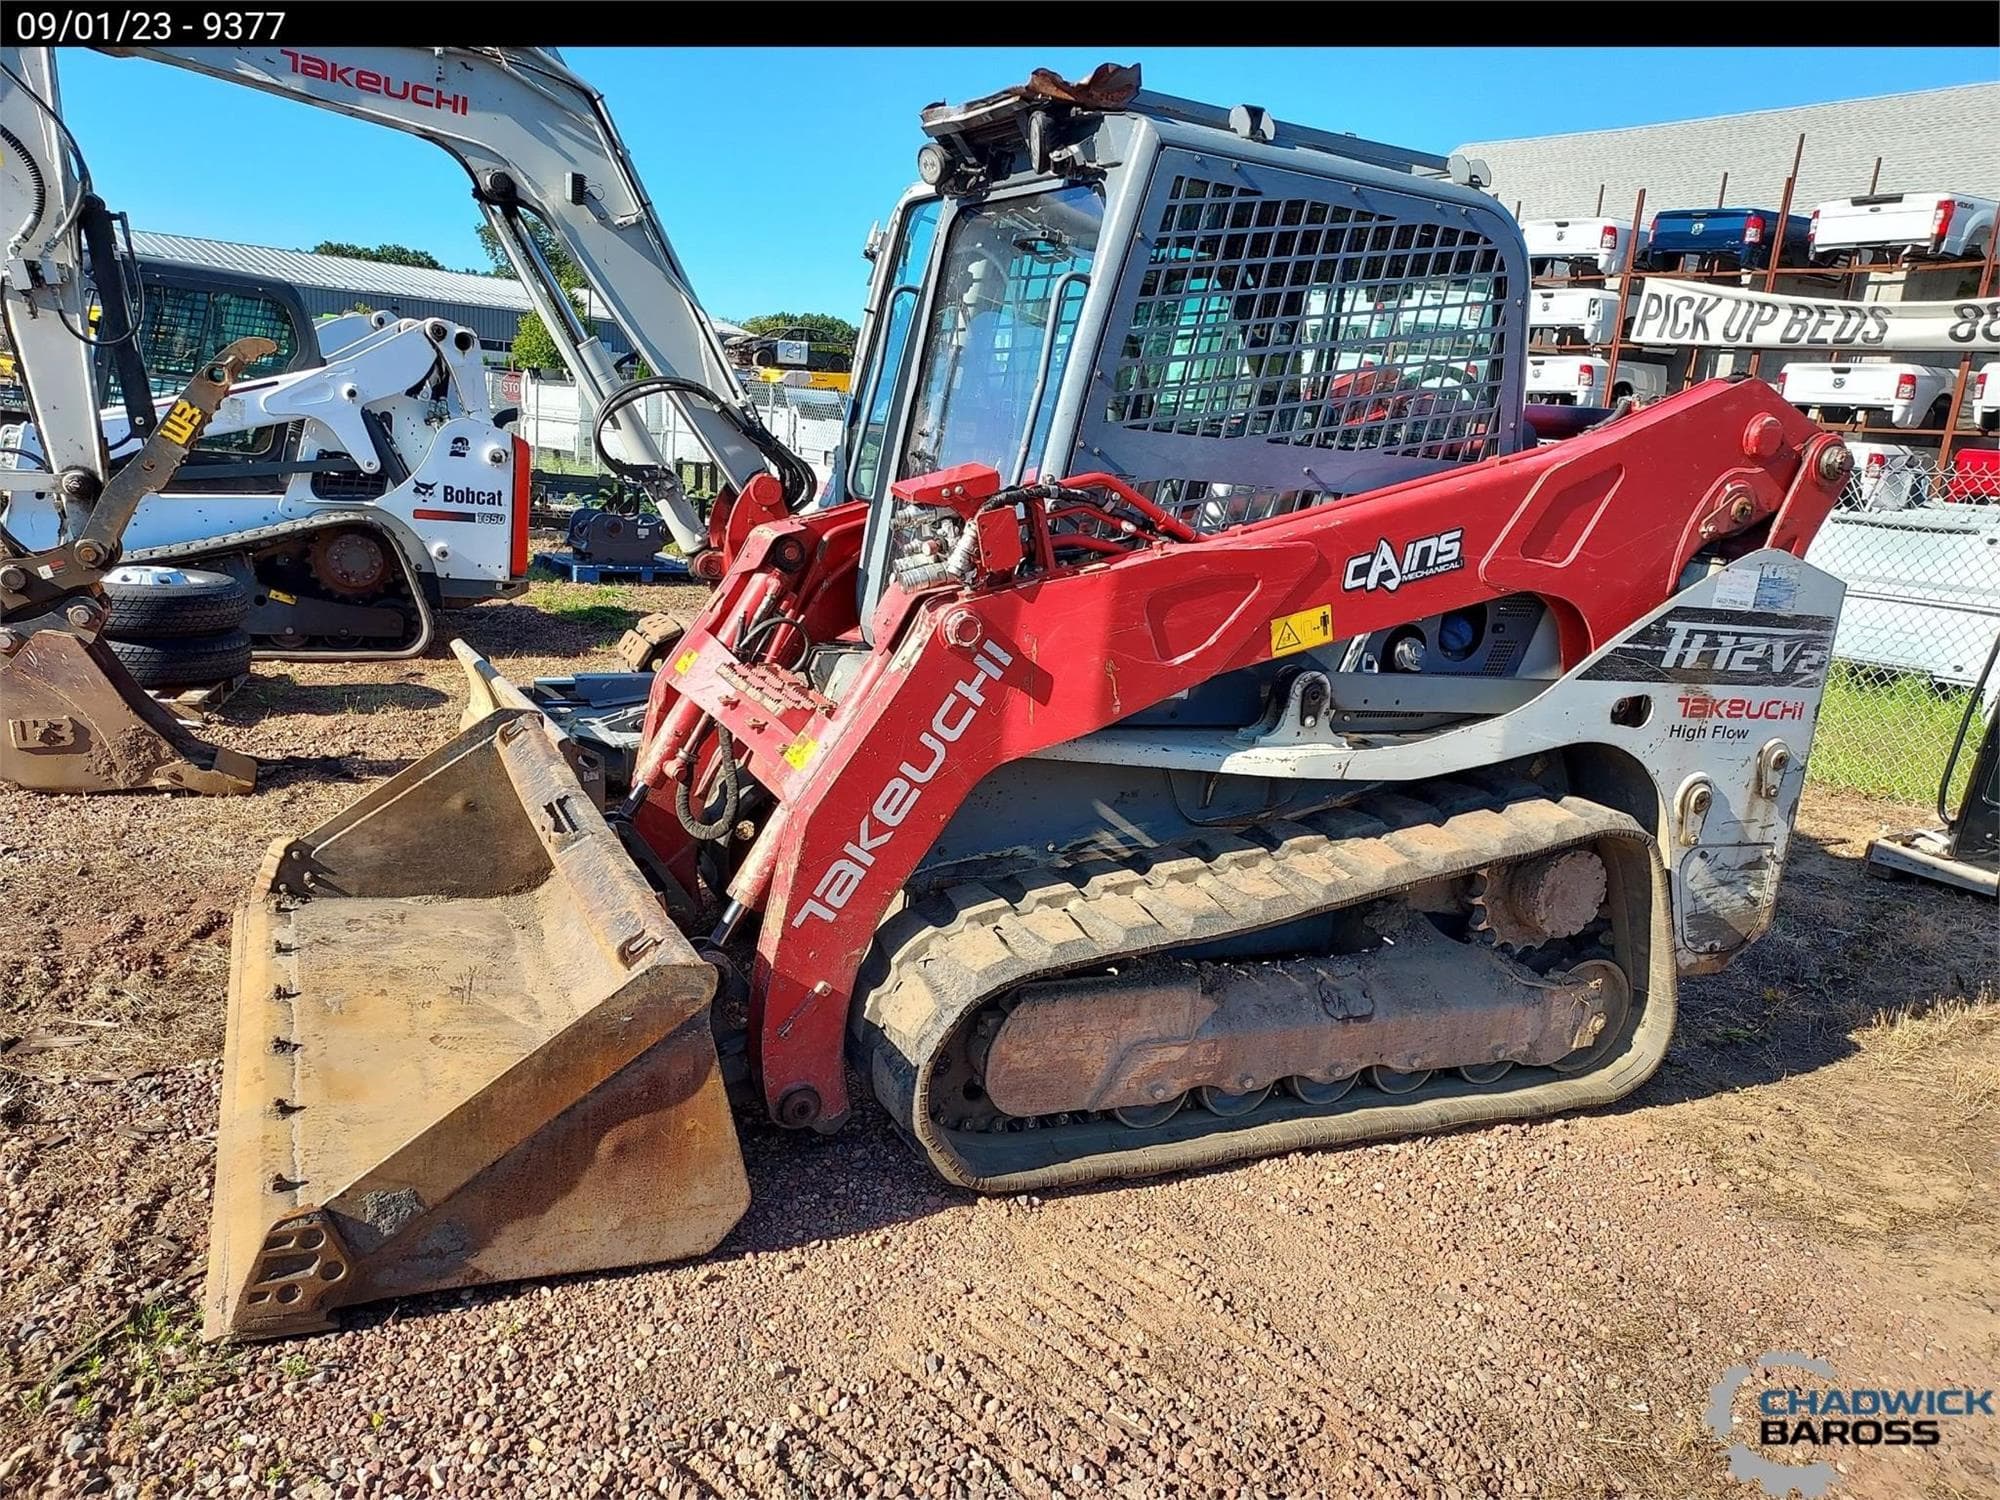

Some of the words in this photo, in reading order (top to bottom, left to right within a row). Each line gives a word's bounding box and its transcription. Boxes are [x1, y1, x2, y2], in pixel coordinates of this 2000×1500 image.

[1635, 292, 1723, 342] PICK
[1722, 299, 1780, 344] UP
[1779, 302, 1893, 345] BEDS
[502, 381, 521, 394] STO
[443, 484, 504, 507] Bobcat
[477, 512, 506, 525] T650
[1401, 560, 1461, 583] MECHANICAL
[1669, 724, 1707, 742] High
[1711, 724, 1750, 740] Flow
